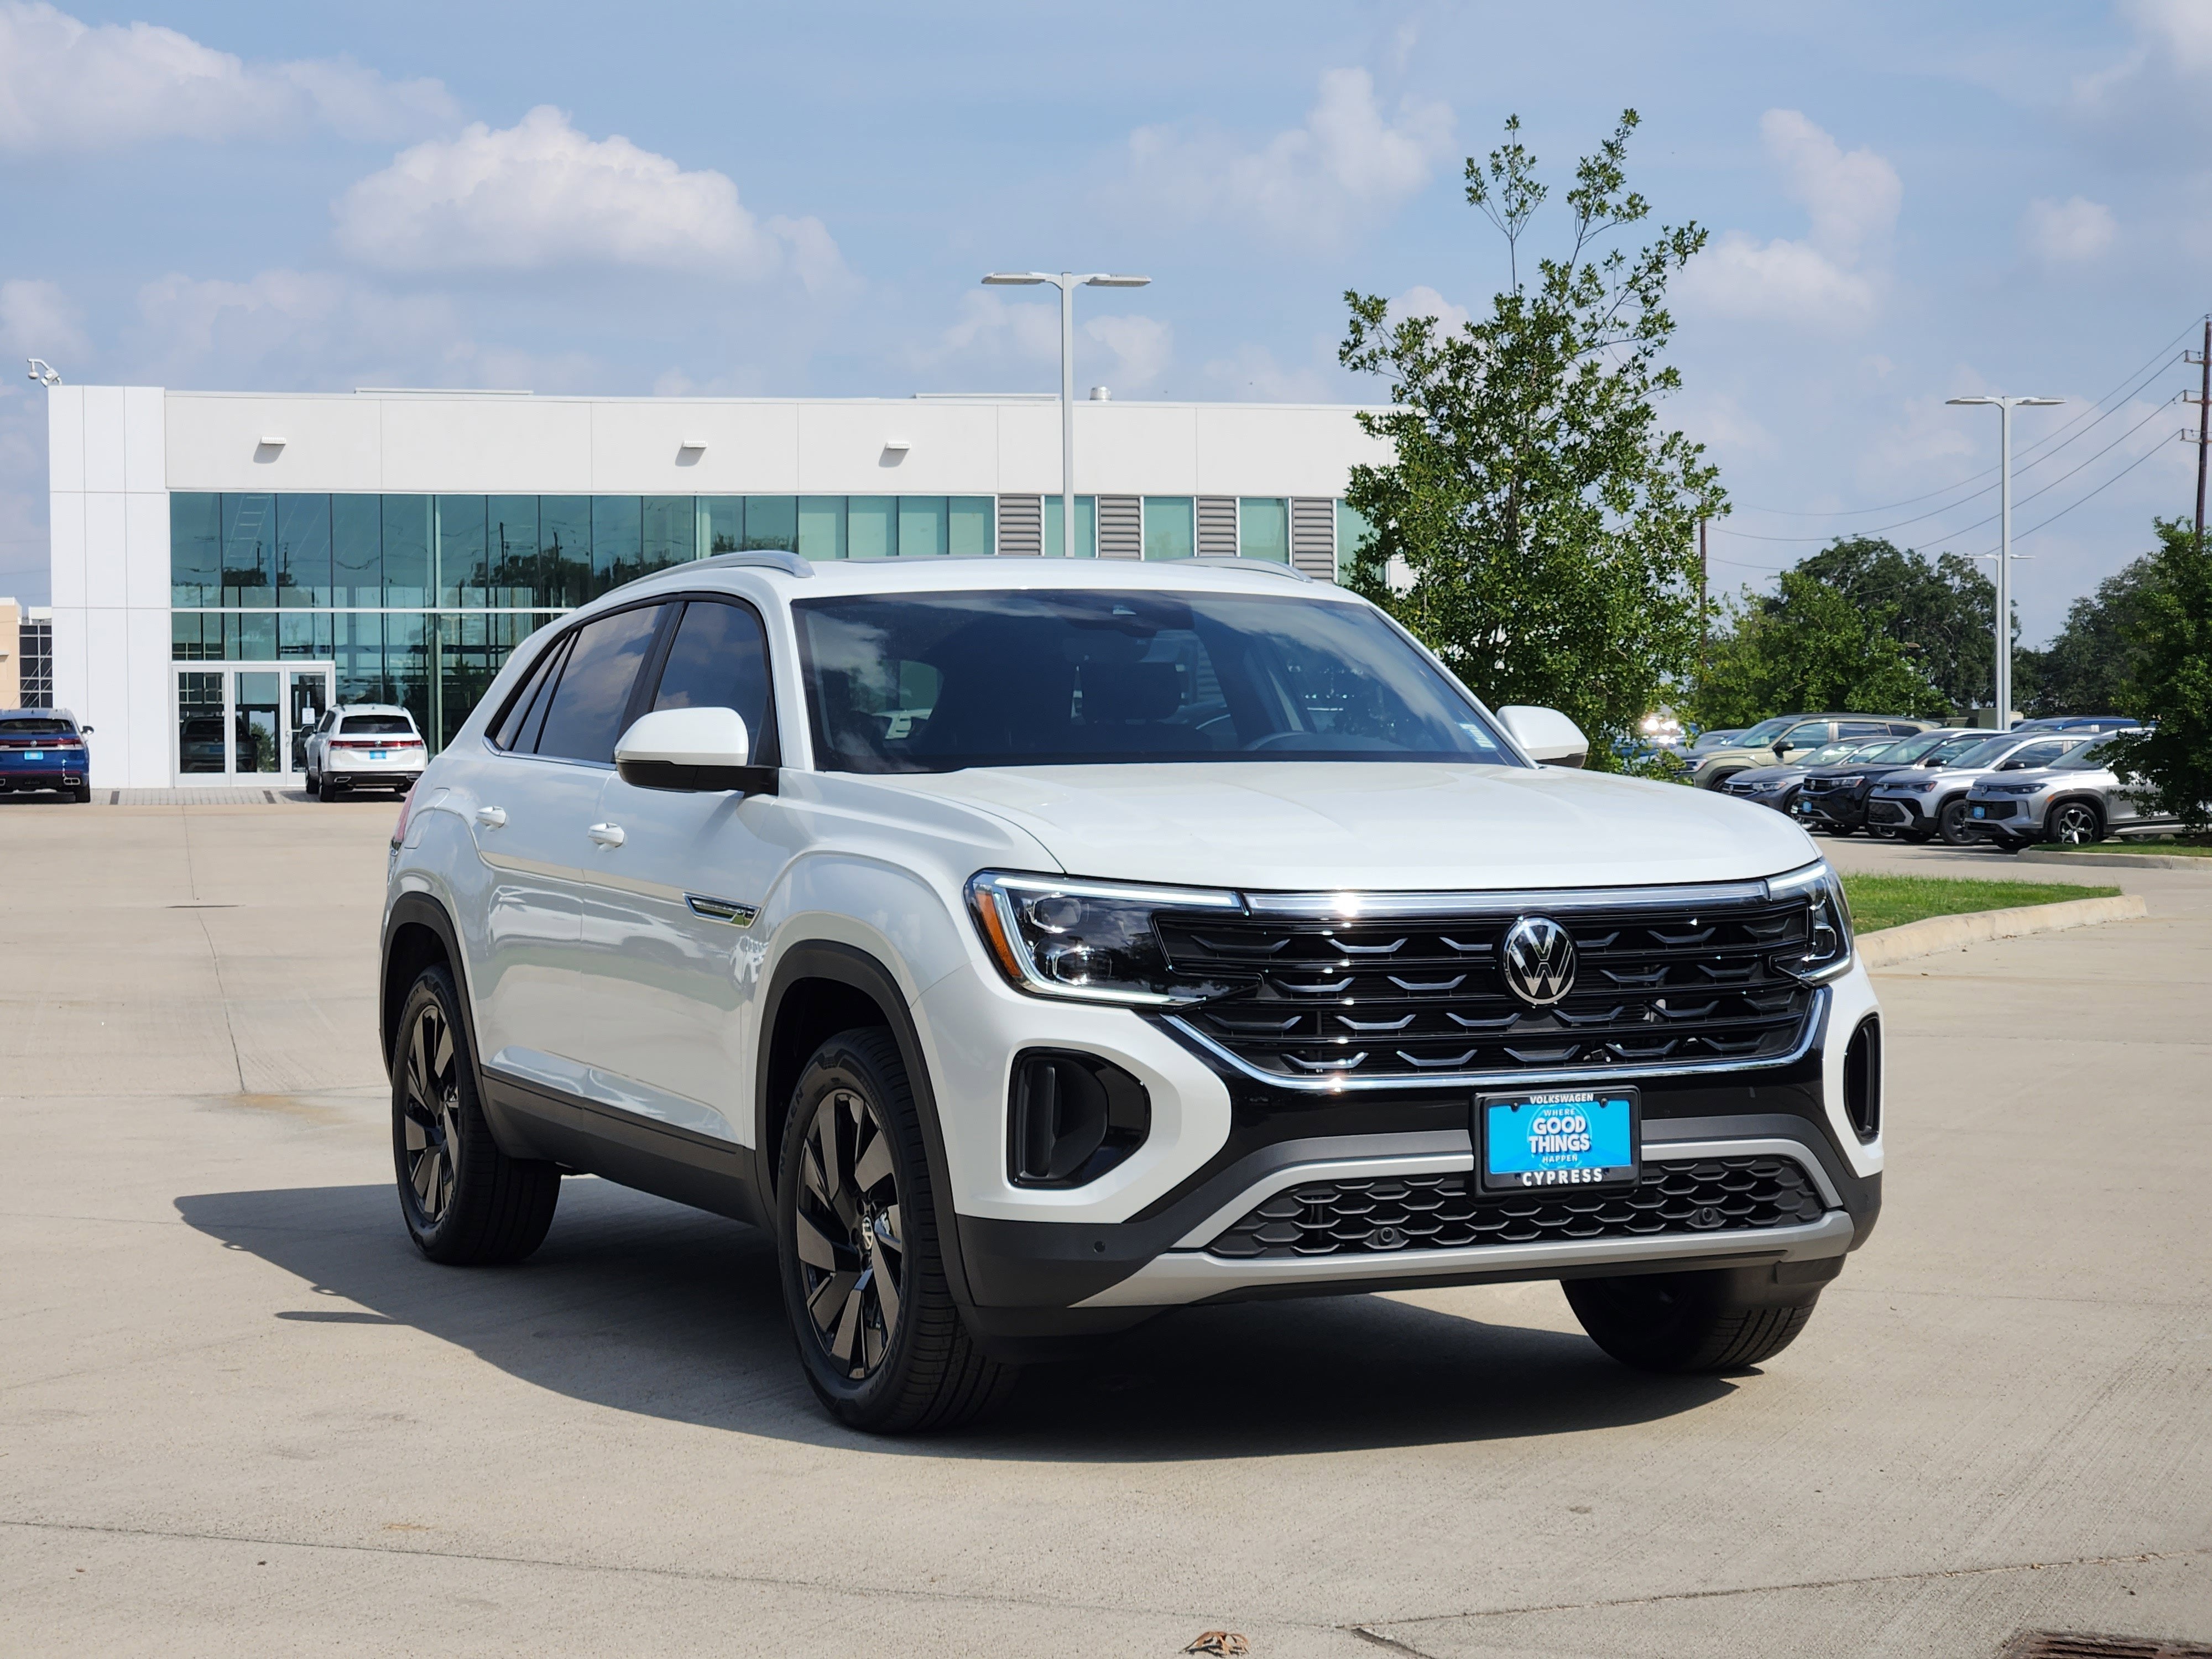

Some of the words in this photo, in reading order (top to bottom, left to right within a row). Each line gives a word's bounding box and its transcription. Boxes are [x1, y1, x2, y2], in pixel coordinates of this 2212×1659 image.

[1530, 1093, 1594, 1104] VOLKSWAGEN
[1544, 1108, 1575, 1117] WHERE
[779, 1086, 804, 1176] NEXEN
[1532, 1115, 1586, 1135] GOOD
[1528, 1134, 1590, 1154] THINGS
[1542, 1154, 1578, 1164] HAPPEN
[1522, 1168, 1603, 1187] CYPRESS
